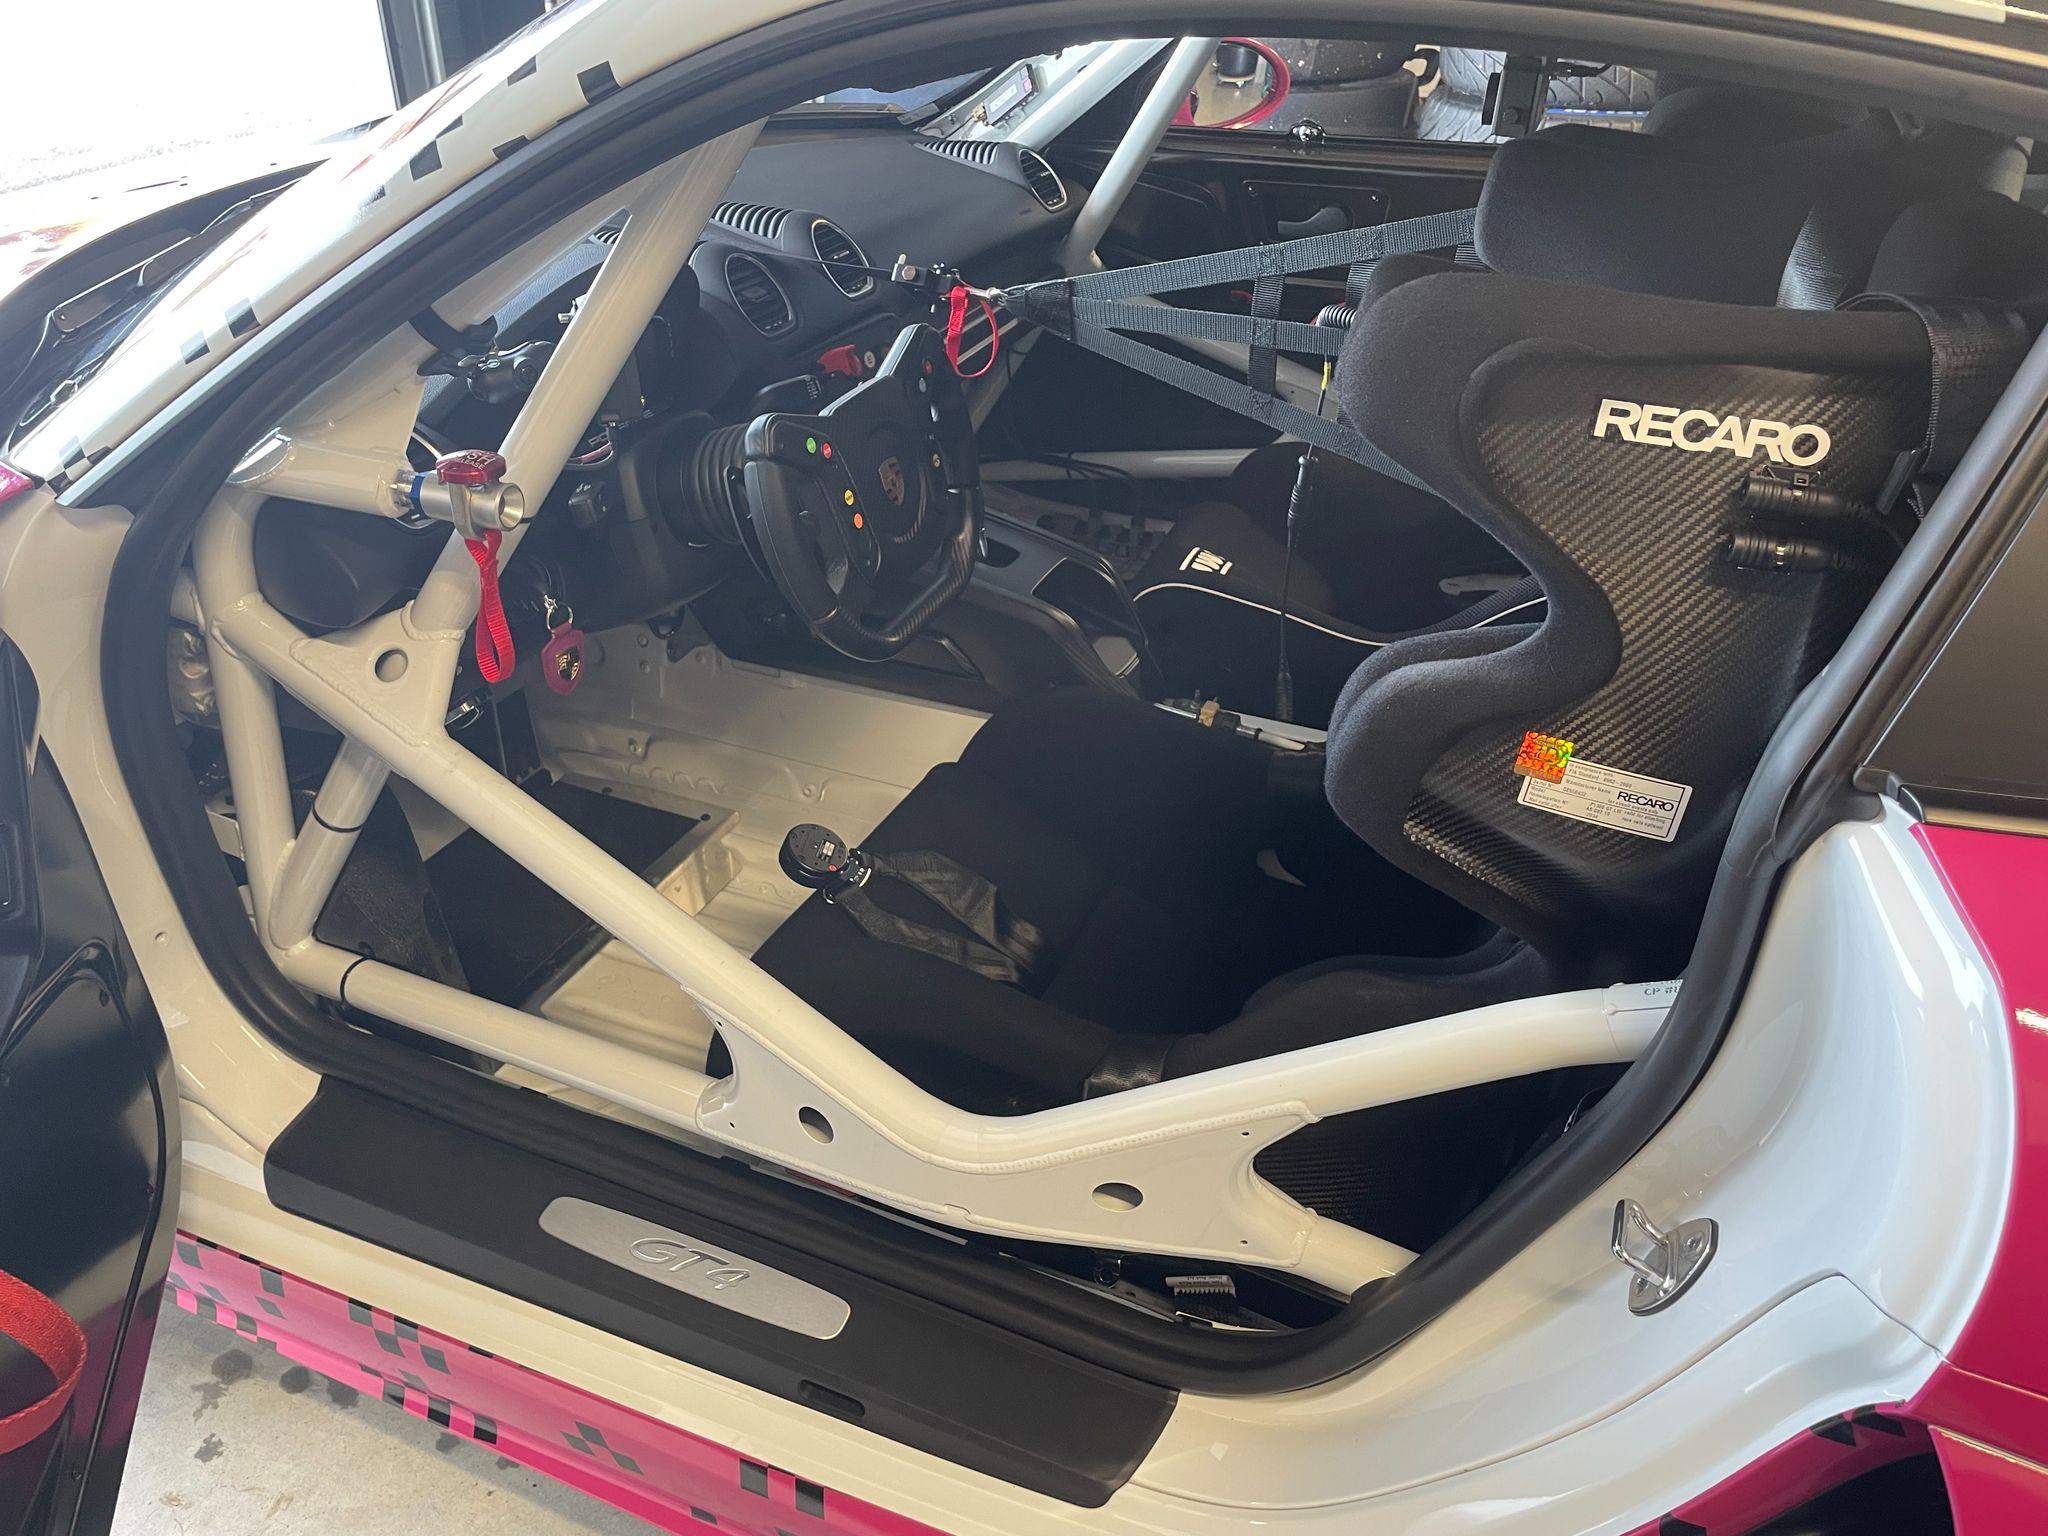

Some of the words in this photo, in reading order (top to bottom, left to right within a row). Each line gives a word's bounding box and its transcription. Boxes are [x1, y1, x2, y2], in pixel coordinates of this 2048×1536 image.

[1593, 398, 1831, 466] RECARO
[1617, 791, 1674, 812] RECARO
[629, 1238, 751, 1290] GT4
